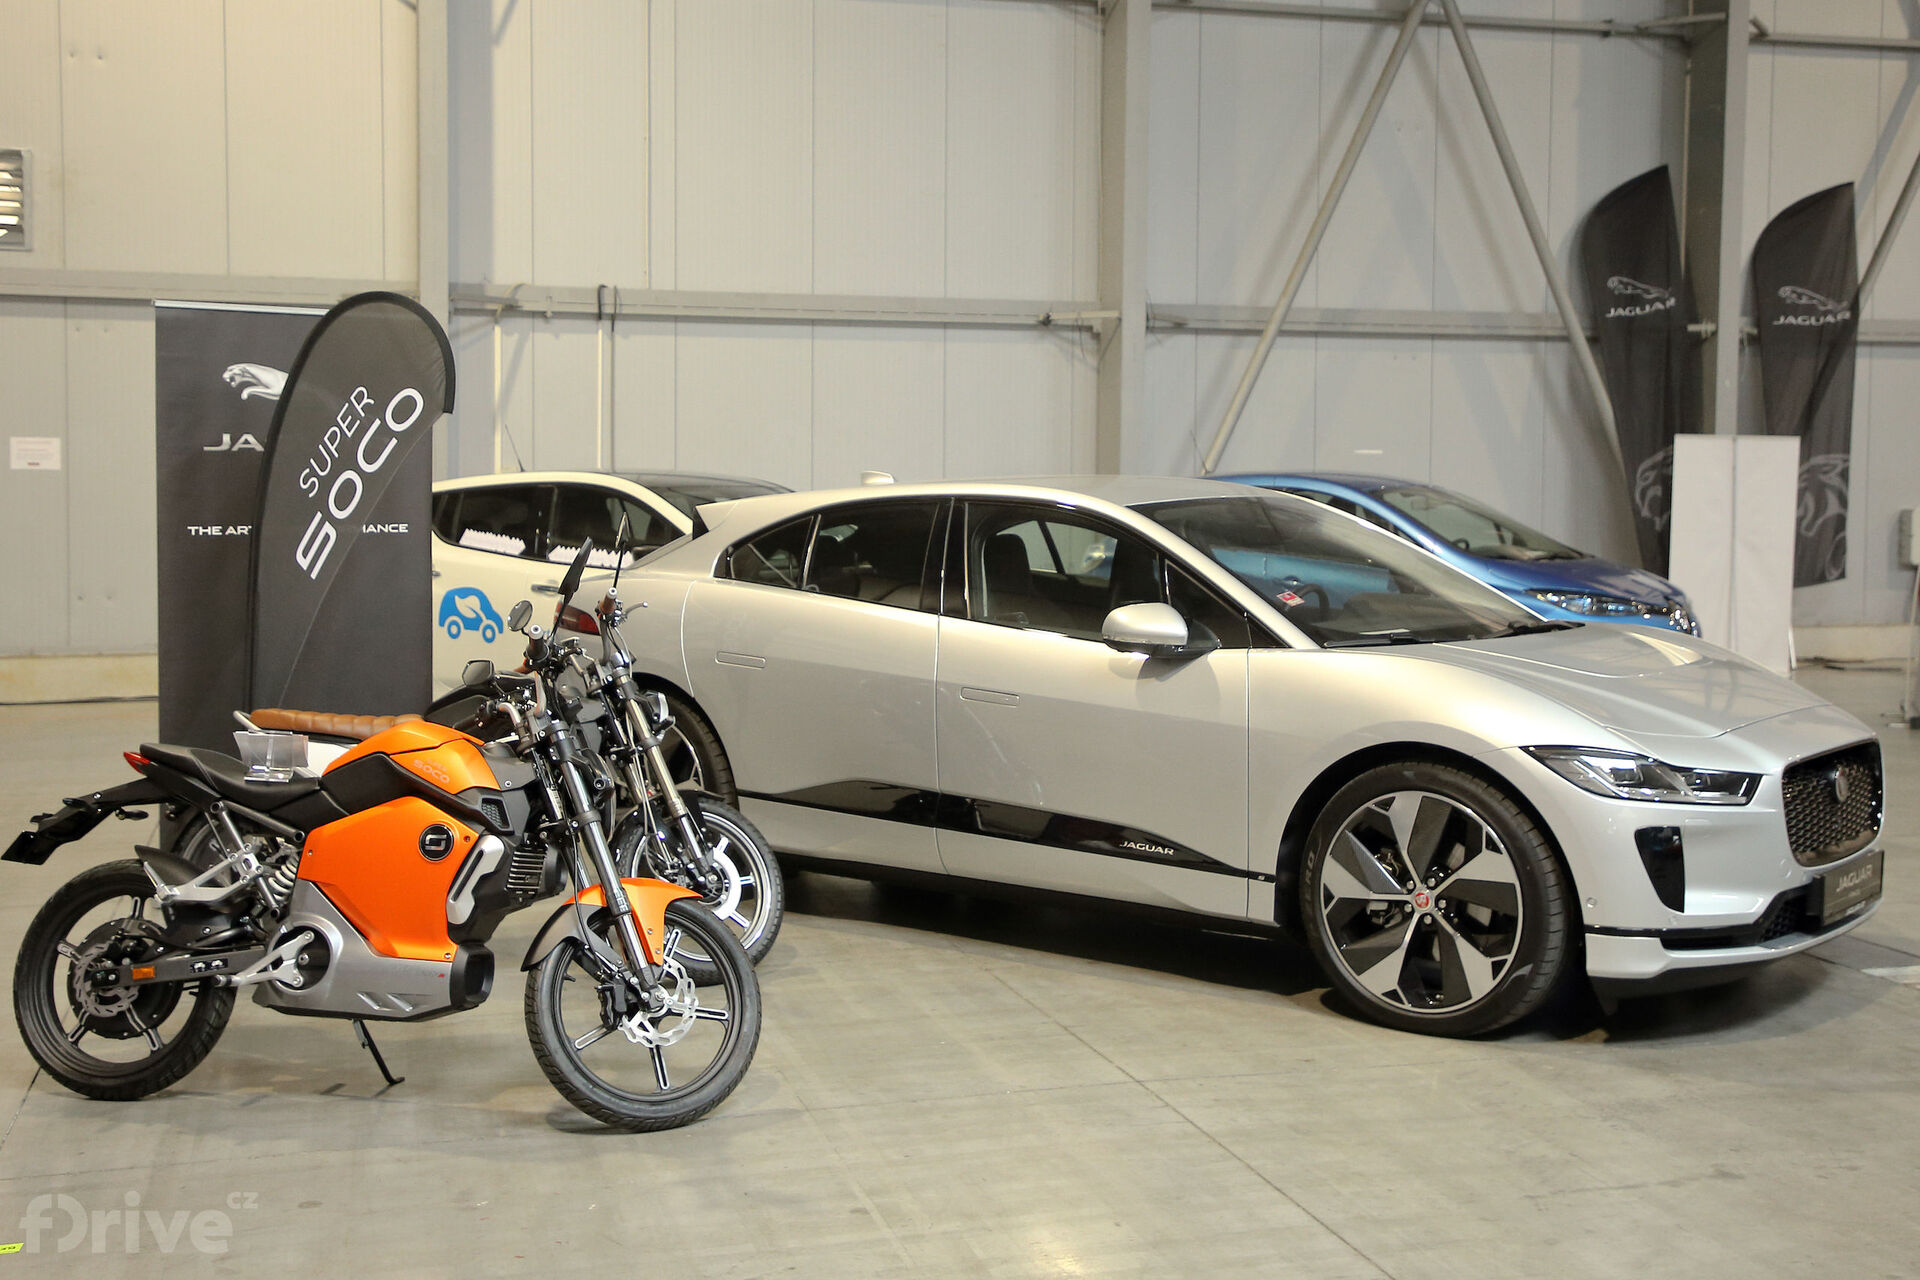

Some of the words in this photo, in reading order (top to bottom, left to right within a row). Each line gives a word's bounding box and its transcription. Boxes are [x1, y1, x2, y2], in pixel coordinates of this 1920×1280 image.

[299, 386, 375, 498] SUPER
[295, 387, 425, 580] SOCO
[187, 526, 222, 536] THE
[1119, 841, 1175, 856] JAGUAR
[1835, 864, 1873, 893] JAGUAR
